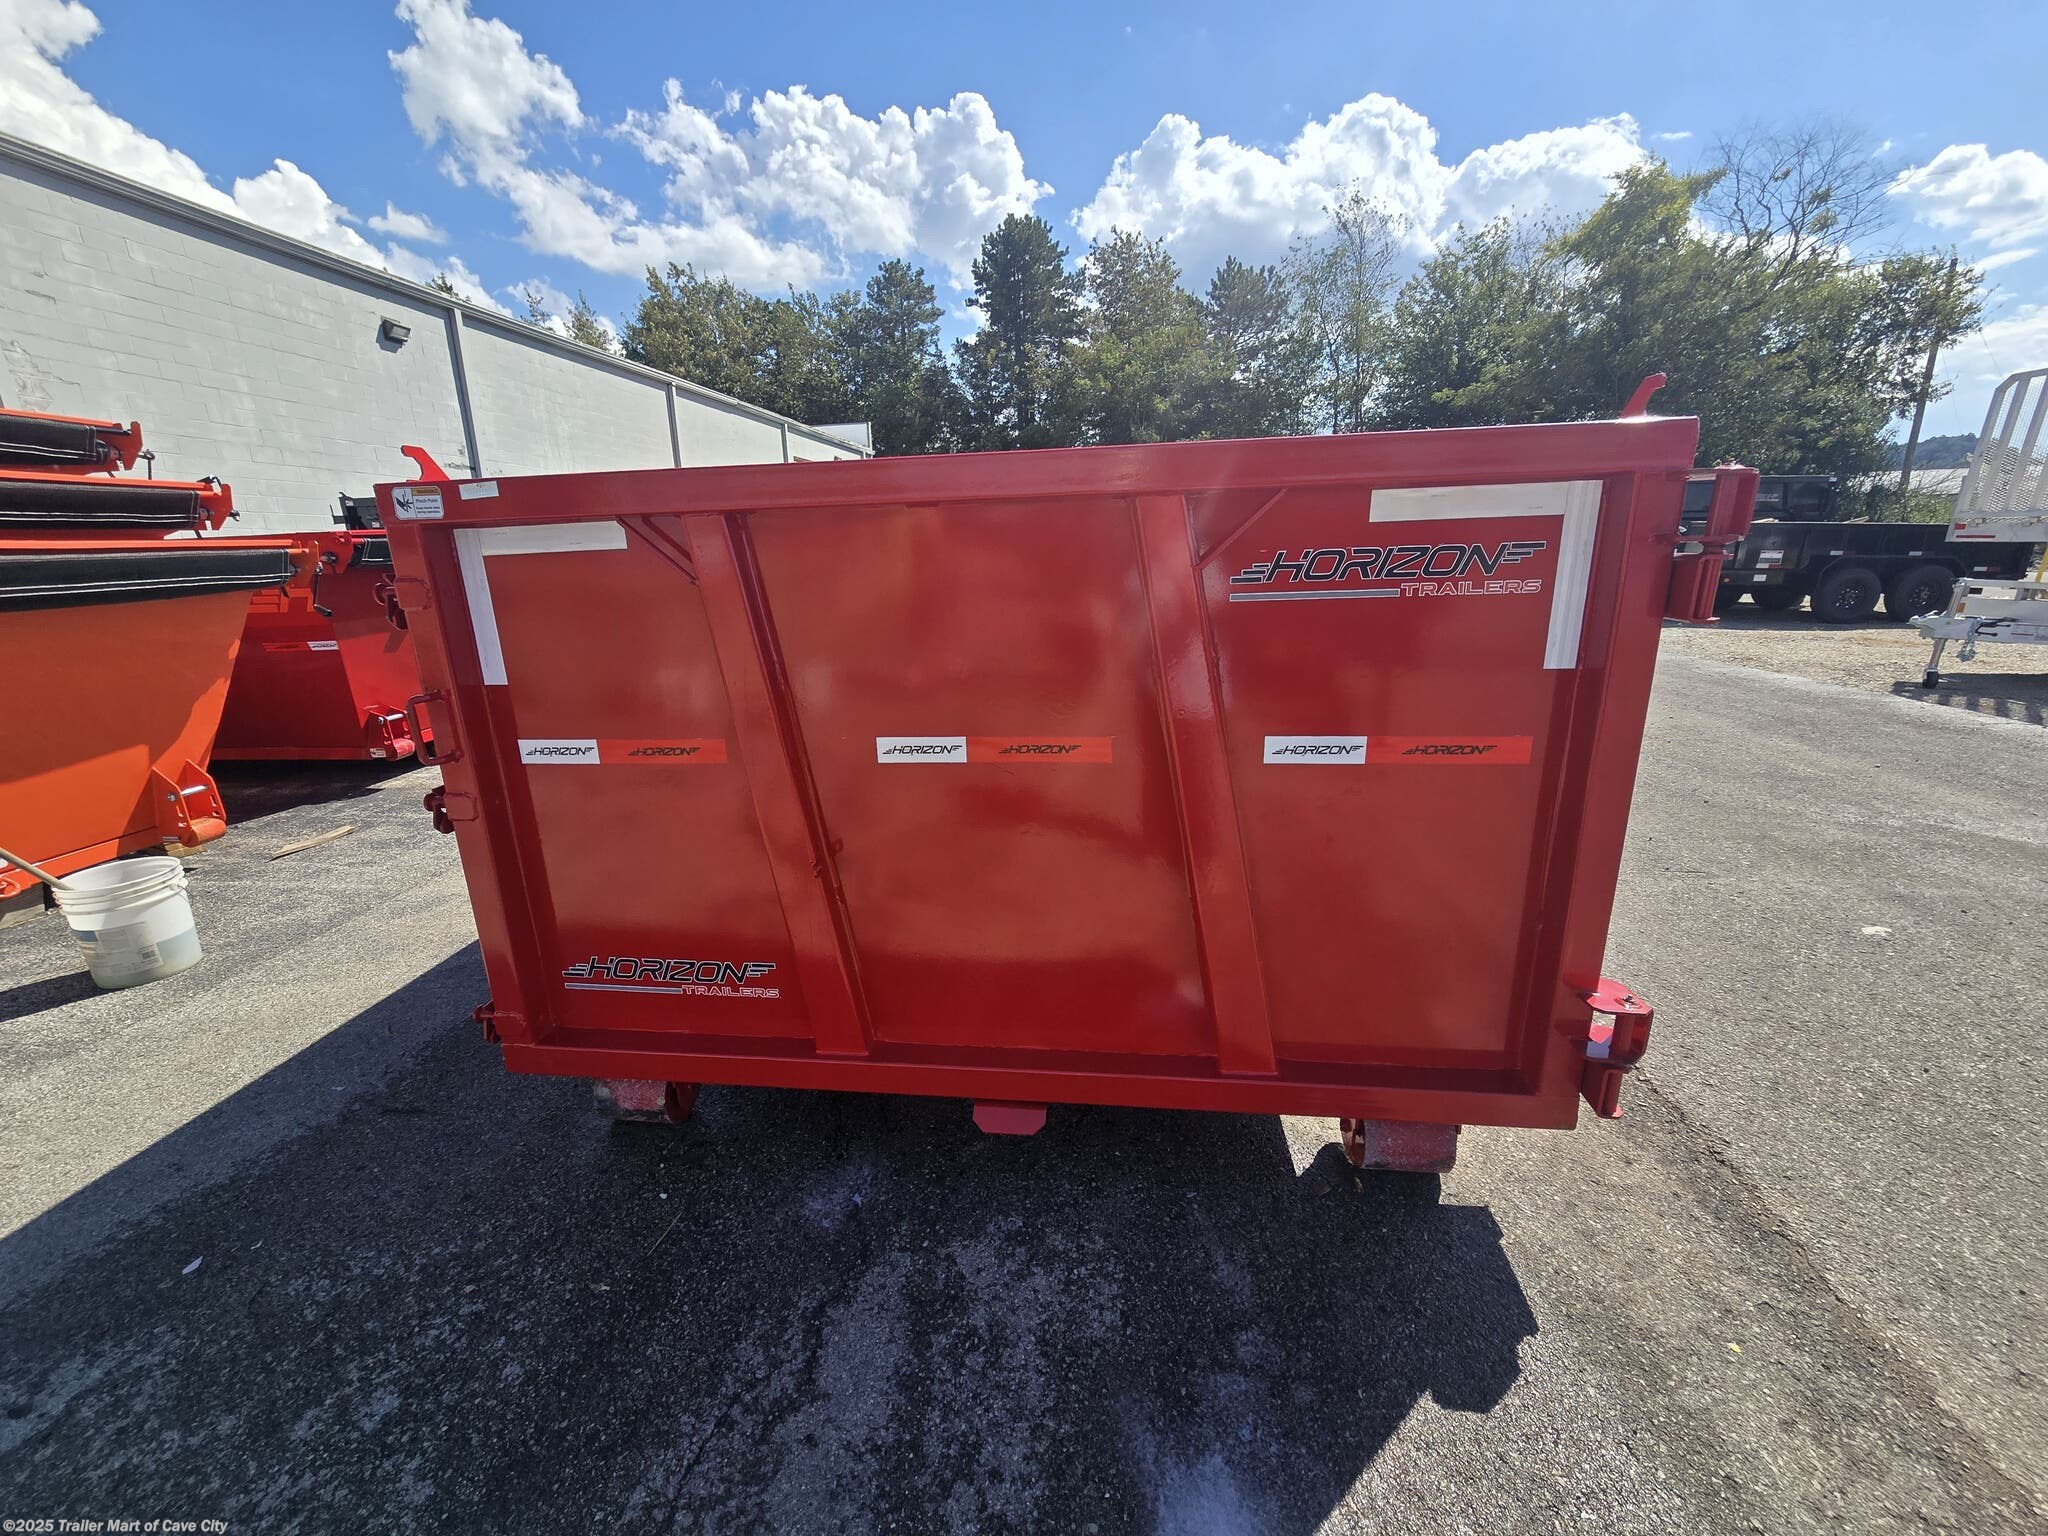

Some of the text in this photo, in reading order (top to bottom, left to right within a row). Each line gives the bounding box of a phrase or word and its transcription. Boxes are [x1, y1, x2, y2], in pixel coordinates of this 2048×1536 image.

[1262, 542, 1510, 583] HORIZON
[1400, 579, 1543, 598] TRAILERS
[532, 746, 588, 757] HORIZON
[635, 746, 692, 757] HORIZON
[891, 744, 954, 756] HORIZON
[1006, 744, 1073, 755] HORIZON
[1282, 744, 1354, 756] HORIZON
[1413, 744, 1489, 756] HORIZON
[586, 955, 752, 985] HORIZON
[681, 984, 781, 999] TRAILERS
